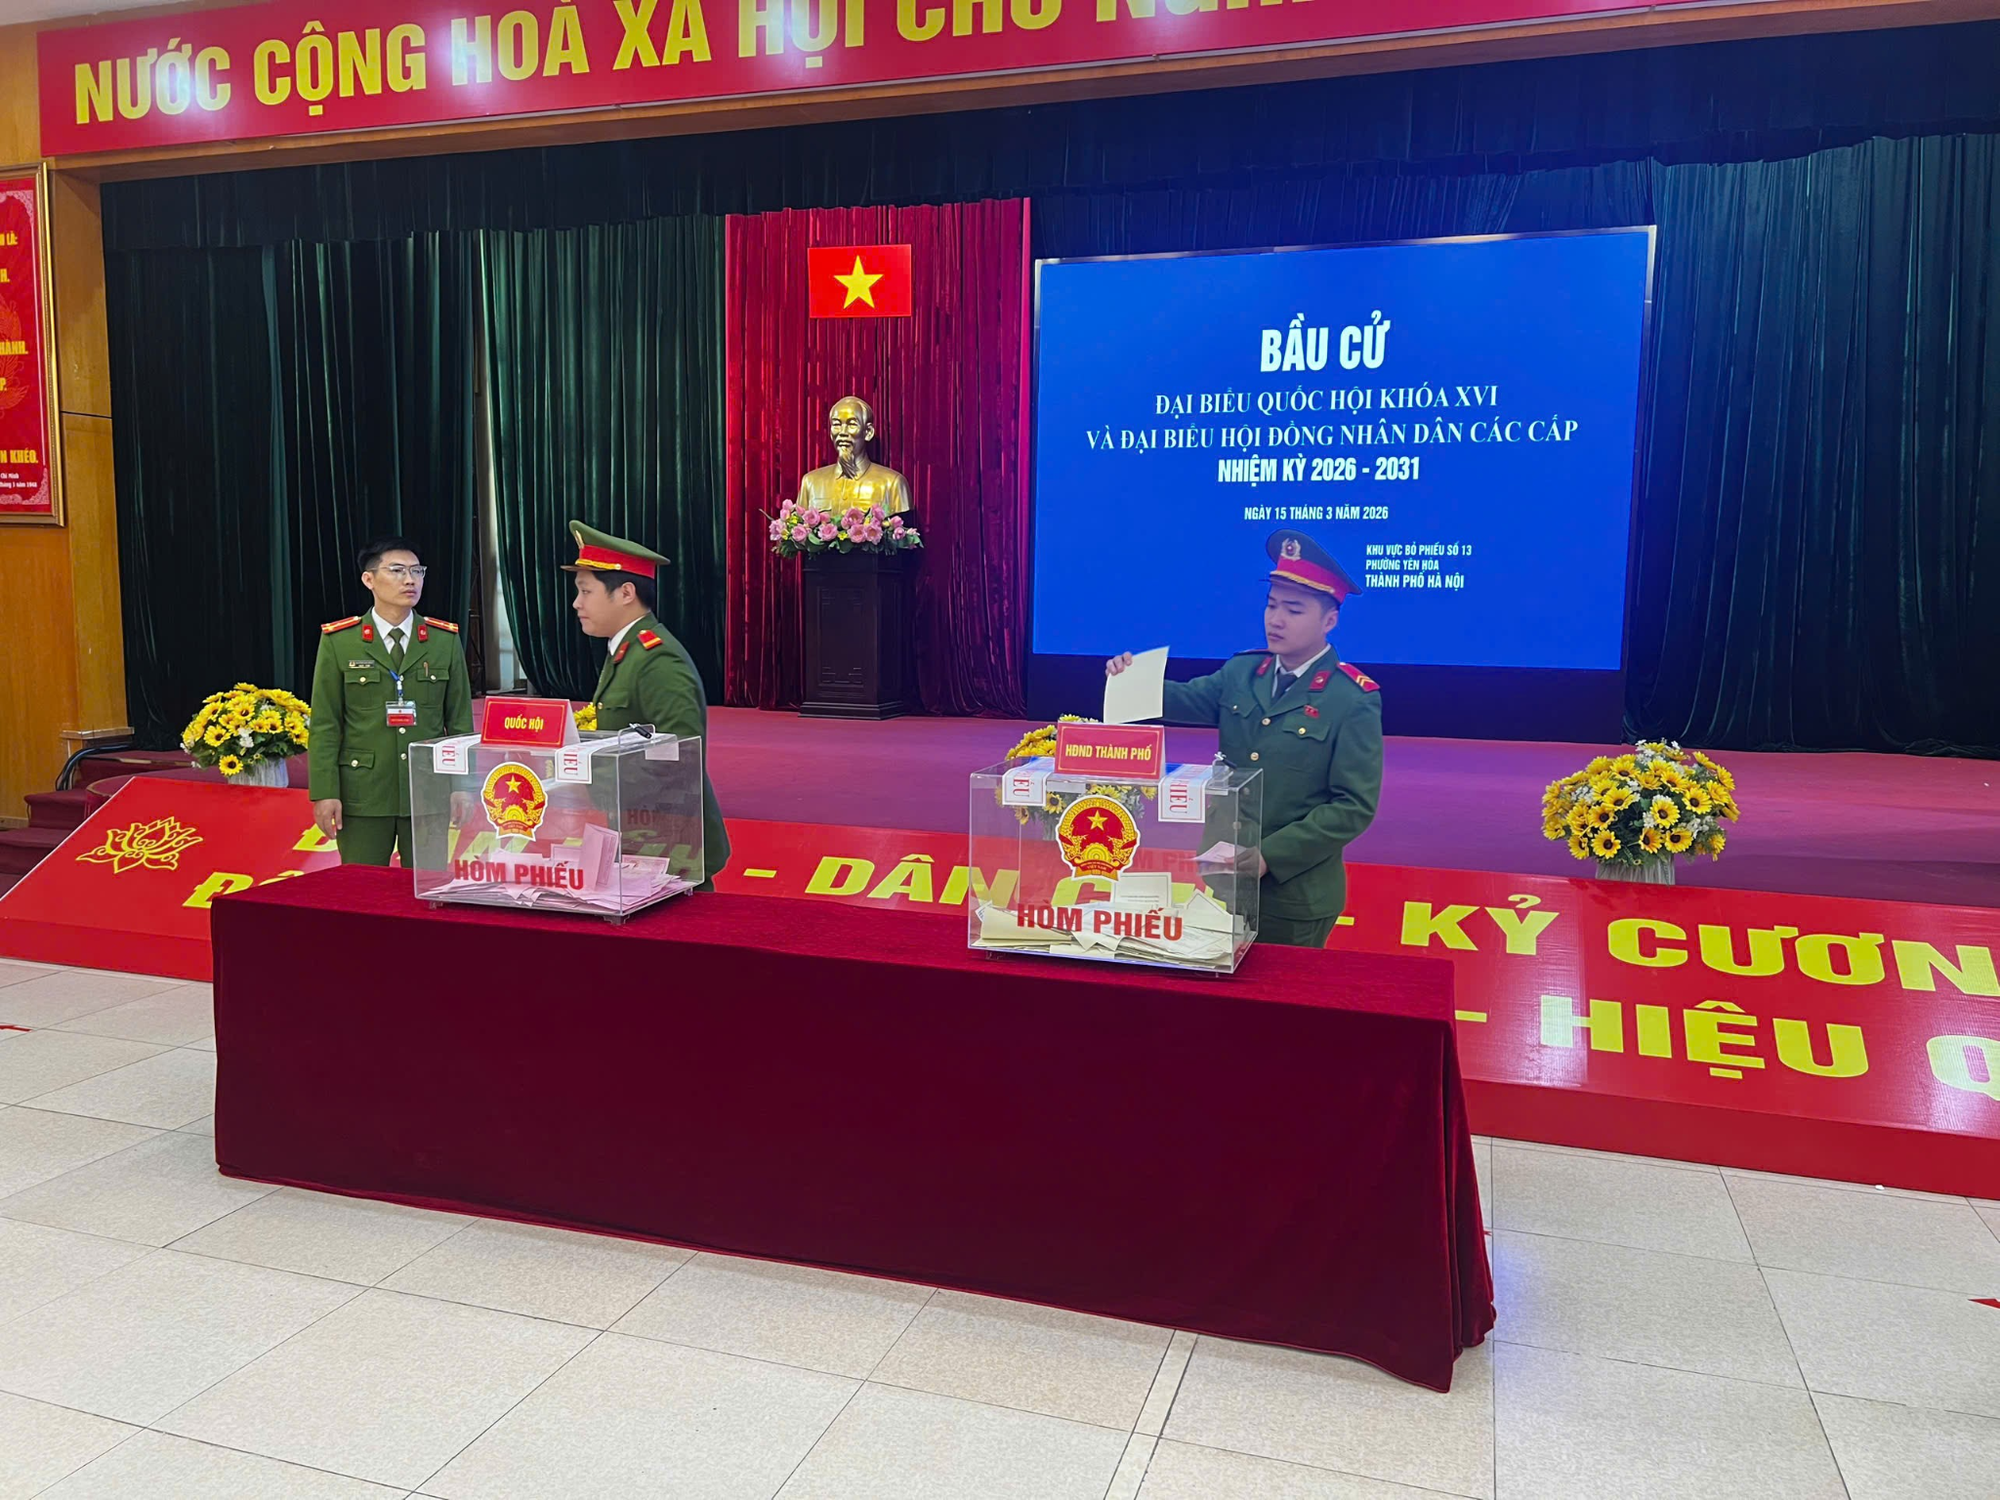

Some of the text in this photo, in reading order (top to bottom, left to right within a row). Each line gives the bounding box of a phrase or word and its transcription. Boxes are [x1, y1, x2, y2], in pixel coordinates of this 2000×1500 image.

[75, 37, 231, 124] NƯỚC
[253, 21, 427, 116] CỘNG
[1260, 309, 1390, 373] BẦU CỬ
[1156, 381, 1497, 420] ĐẠI BIỂU QUỐC HỘI KHÓA XVI
[1086, 414, 1578, 454] VÀ ĐẠI BIỂU HỘI ĐỒNG NHÂN DÂN CÁC CẤP
[1217, 453, 1277, 488] NHIỆM
[1282, 452, 1306, 482] KỲ
[1310, 457, 1356, 481] 2026
[1374, 456, 1419, 481] 2031
[1244, 504, 1388, 520] NGÀY 15 THÁNG 3 NĂM 2026
[1365, 558, 1439, 571] PHƯỜNG YÊN HÒA
[1366, 541, 1471, 558] KHU VỰC BỎ PHIẾU SỐ 13
[1365, 570, 1464, 591] THÀNH PHỐ HÀ NỘI
[504, 714, 544, 732] QUỐC HỘI
[1065, 743, 1152, 761] HĐND THÀNH PHỐ
[454, 856, 584, 890] HÒM PHIẾU
[805, 854, 1020, 909] DÂN
[1016, 899, 1183, 941] HÒM PHIẾU
[1401, 894, 1560, 956] KỶ
[1540, 994, 1869, 1079] HIỆU
